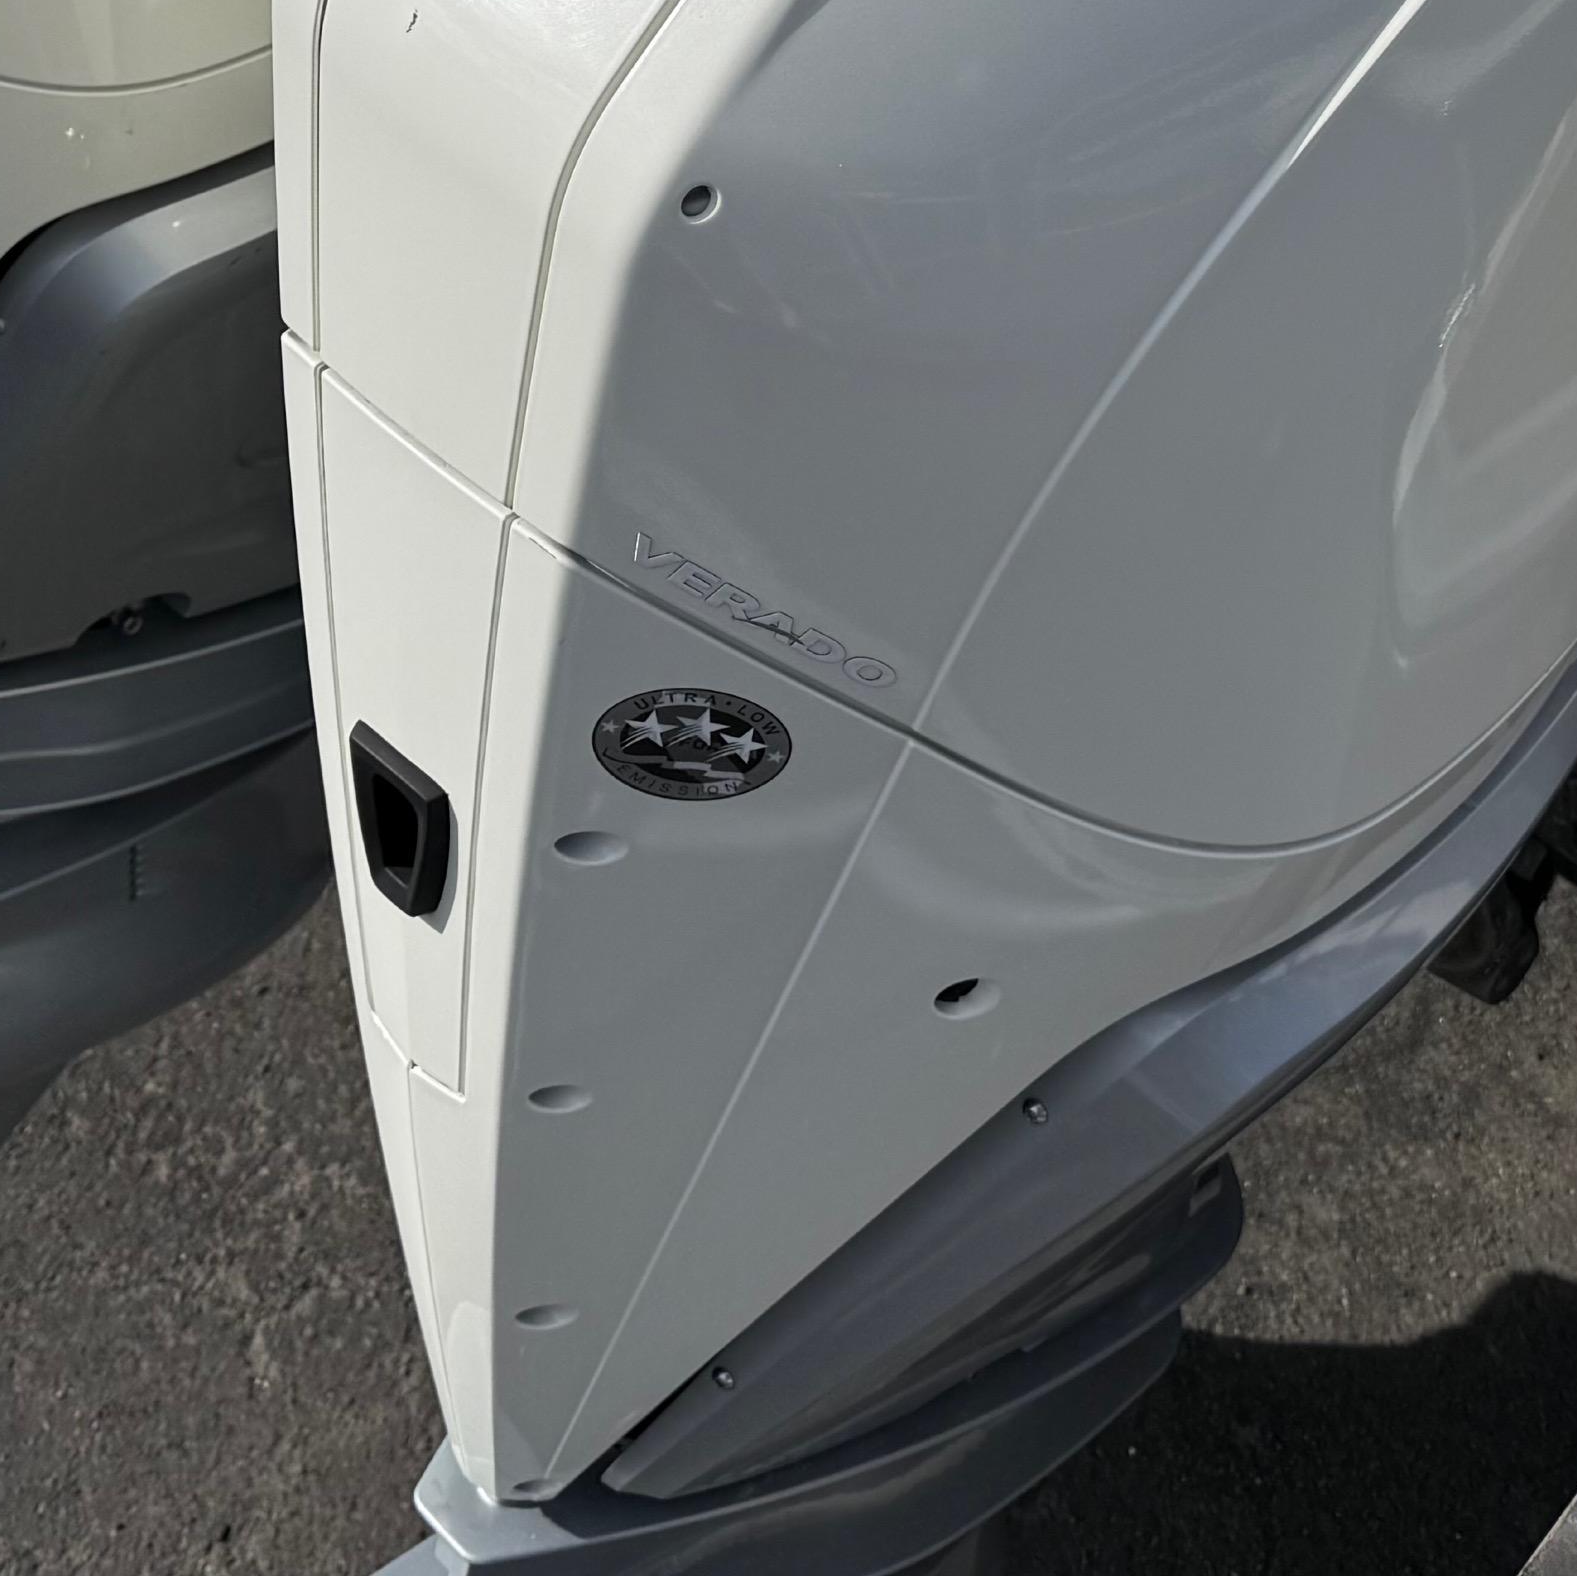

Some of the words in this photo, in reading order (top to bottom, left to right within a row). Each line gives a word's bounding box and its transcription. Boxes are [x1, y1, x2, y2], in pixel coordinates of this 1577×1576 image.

[633, 531, 896, 689] VERADO
[633, 691, 718, 711] ULTRA
[737, 704, 781, 737] LOW
